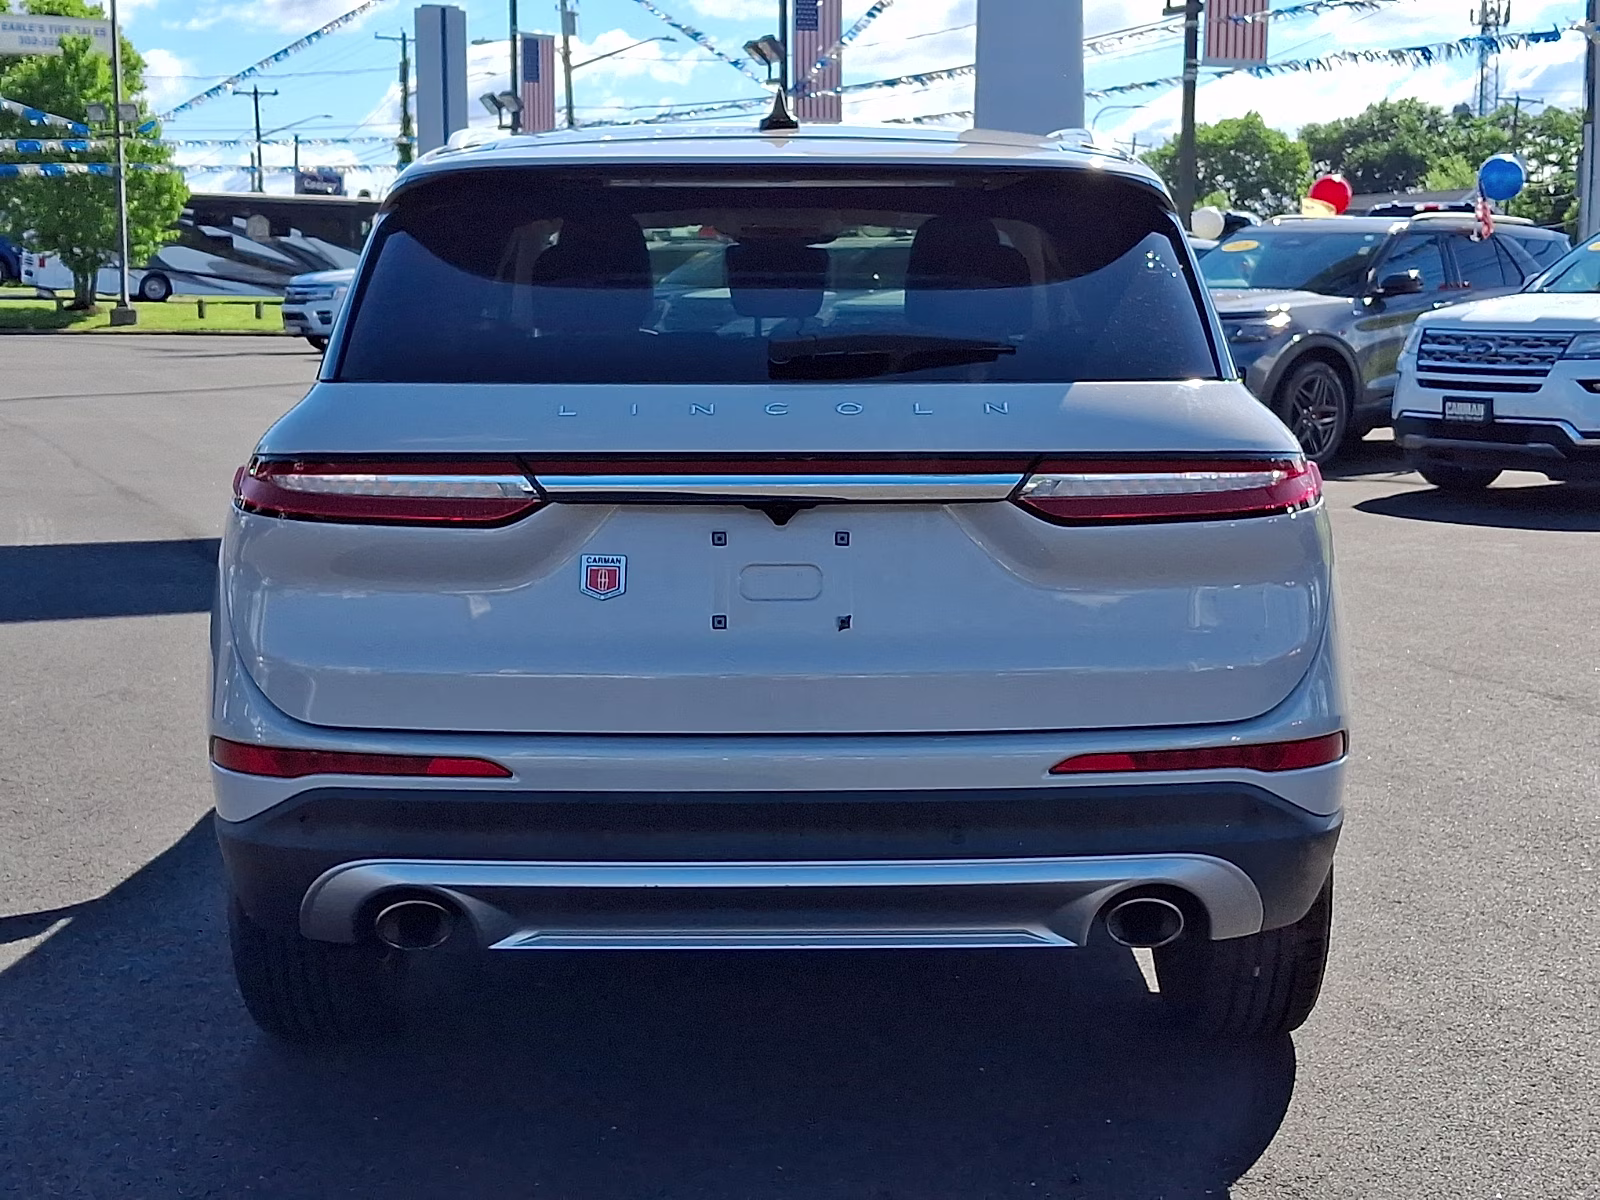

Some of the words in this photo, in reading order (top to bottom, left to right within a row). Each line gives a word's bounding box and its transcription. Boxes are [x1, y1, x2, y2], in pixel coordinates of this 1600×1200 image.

[1, 21, 45, 33] EARLE'S
[49, 24, 71, 35] TIRE
[557, 401, 1010, 417] LINCOLN
[586, 555, 622, 565] CARMAN
